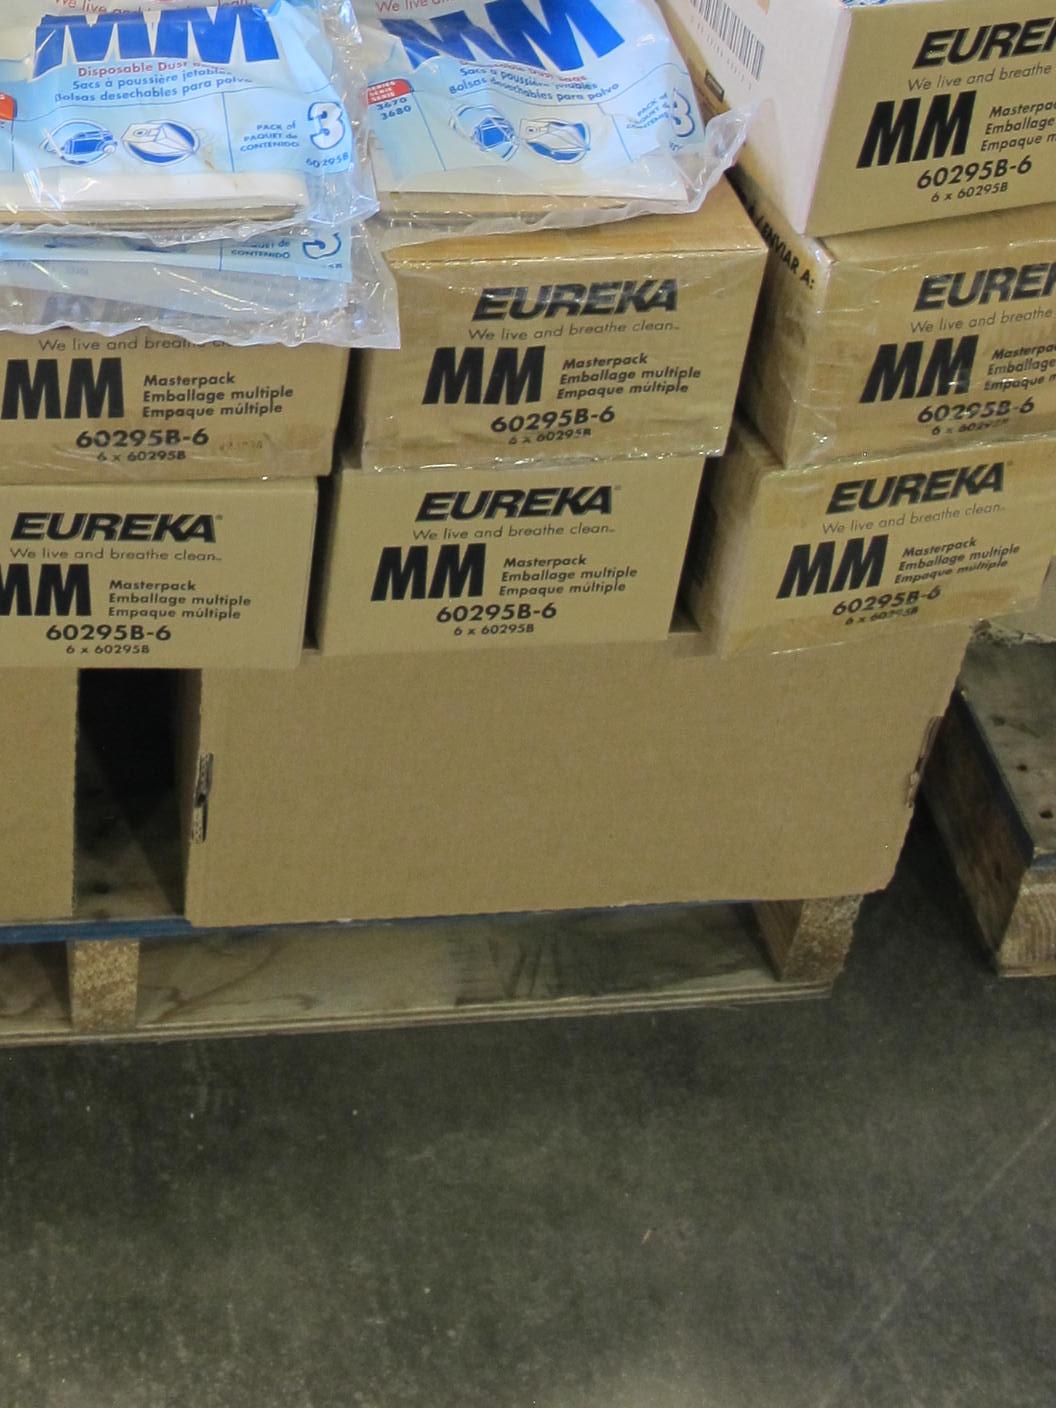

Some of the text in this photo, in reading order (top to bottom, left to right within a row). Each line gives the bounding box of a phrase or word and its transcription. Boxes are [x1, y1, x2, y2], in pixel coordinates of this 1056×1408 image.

[375, 0, 401, 14] We
[36, 6, 280, 82] MM
[78, 63, 153, 78] Disposable
[999, 62, 1052, 81] breathe
[73, 80, 101, 90] Sacs
[117, 74, 178, 90] poussière
[100, 86, 178, 103] desechables
[182, 80, 212, 95] para
[556, 91, 585, 103] para
[588, 83, 620, 102] polvo
[381, 105, 412, 121] 3680
[307, 100, 345, 150] 3
[855, 90, 978, 169] MM
[985, 117, 1056, 136] Emballage
[240, 140, 300, 152] CONTENIDO
[980, 135, 1043, 153] Empaque
[916, 154, 1033, 190] 60295B-6
[231, 248, 292, 260] CONTENIDO
[800, 268, 815, 290] A:
[471, 278, 678, 322] EUREKA
[1001, 309, 1053, 325] breathe
[569, 322, 627, 336] breathe
[562, 353, 648, 371] Masterpack
[858, 334, 980, 405] MM
[987, 359, 1056, 377] Emballage
[143, 372, 236, 390] Masterpack
[421, 345, 546, 406] MM
[559, 369, 636, 385] Emballage
[1, 356, 126, 420] MM
[142, 388, 226, 405] Emballage
[556, 384, 624, 401] Empaque
[142, 404, 215, 421] Empaque
[490, 405, 616, 434] 60295B-6
[75, 428, 210, 450] 60295B-6
[825, 462, 1005, 515] EUREKA
[414, 485, 613, 523] EUREKA
[910, 507, 961, 525] breathe
[10, 512, 217, 543] EUREKA
[508, 524, 565, 538] breathe
[10, 547, 169, 560] We live and breathe
[902, 536, 977, 559] Masterpack
[503, 554, 588, 569] Masterpack
[776, 534, 890, 600] MM
[897, 553, 966, 573] Emballage
[370, 542, 487, 602] MM
[501, 566, 638, 583] Emballage multiple
[893, 567, 954, 585] Empaque
[109, 579, 197, 593] Masterpack
[499, 585, 565, 598] Empaque
[108, 593, 252, 611] Emballage multiple
[831, 585, 942, 617] 60295B-6
[108, 607, 176, 621] Empaque
[436, 602, 558, 624] 60295B-6
[46, 624, 172, 642] 60295B-6
[480, 623, 535, 635] 60295B
[95, 644, 150, 655] 60295B
